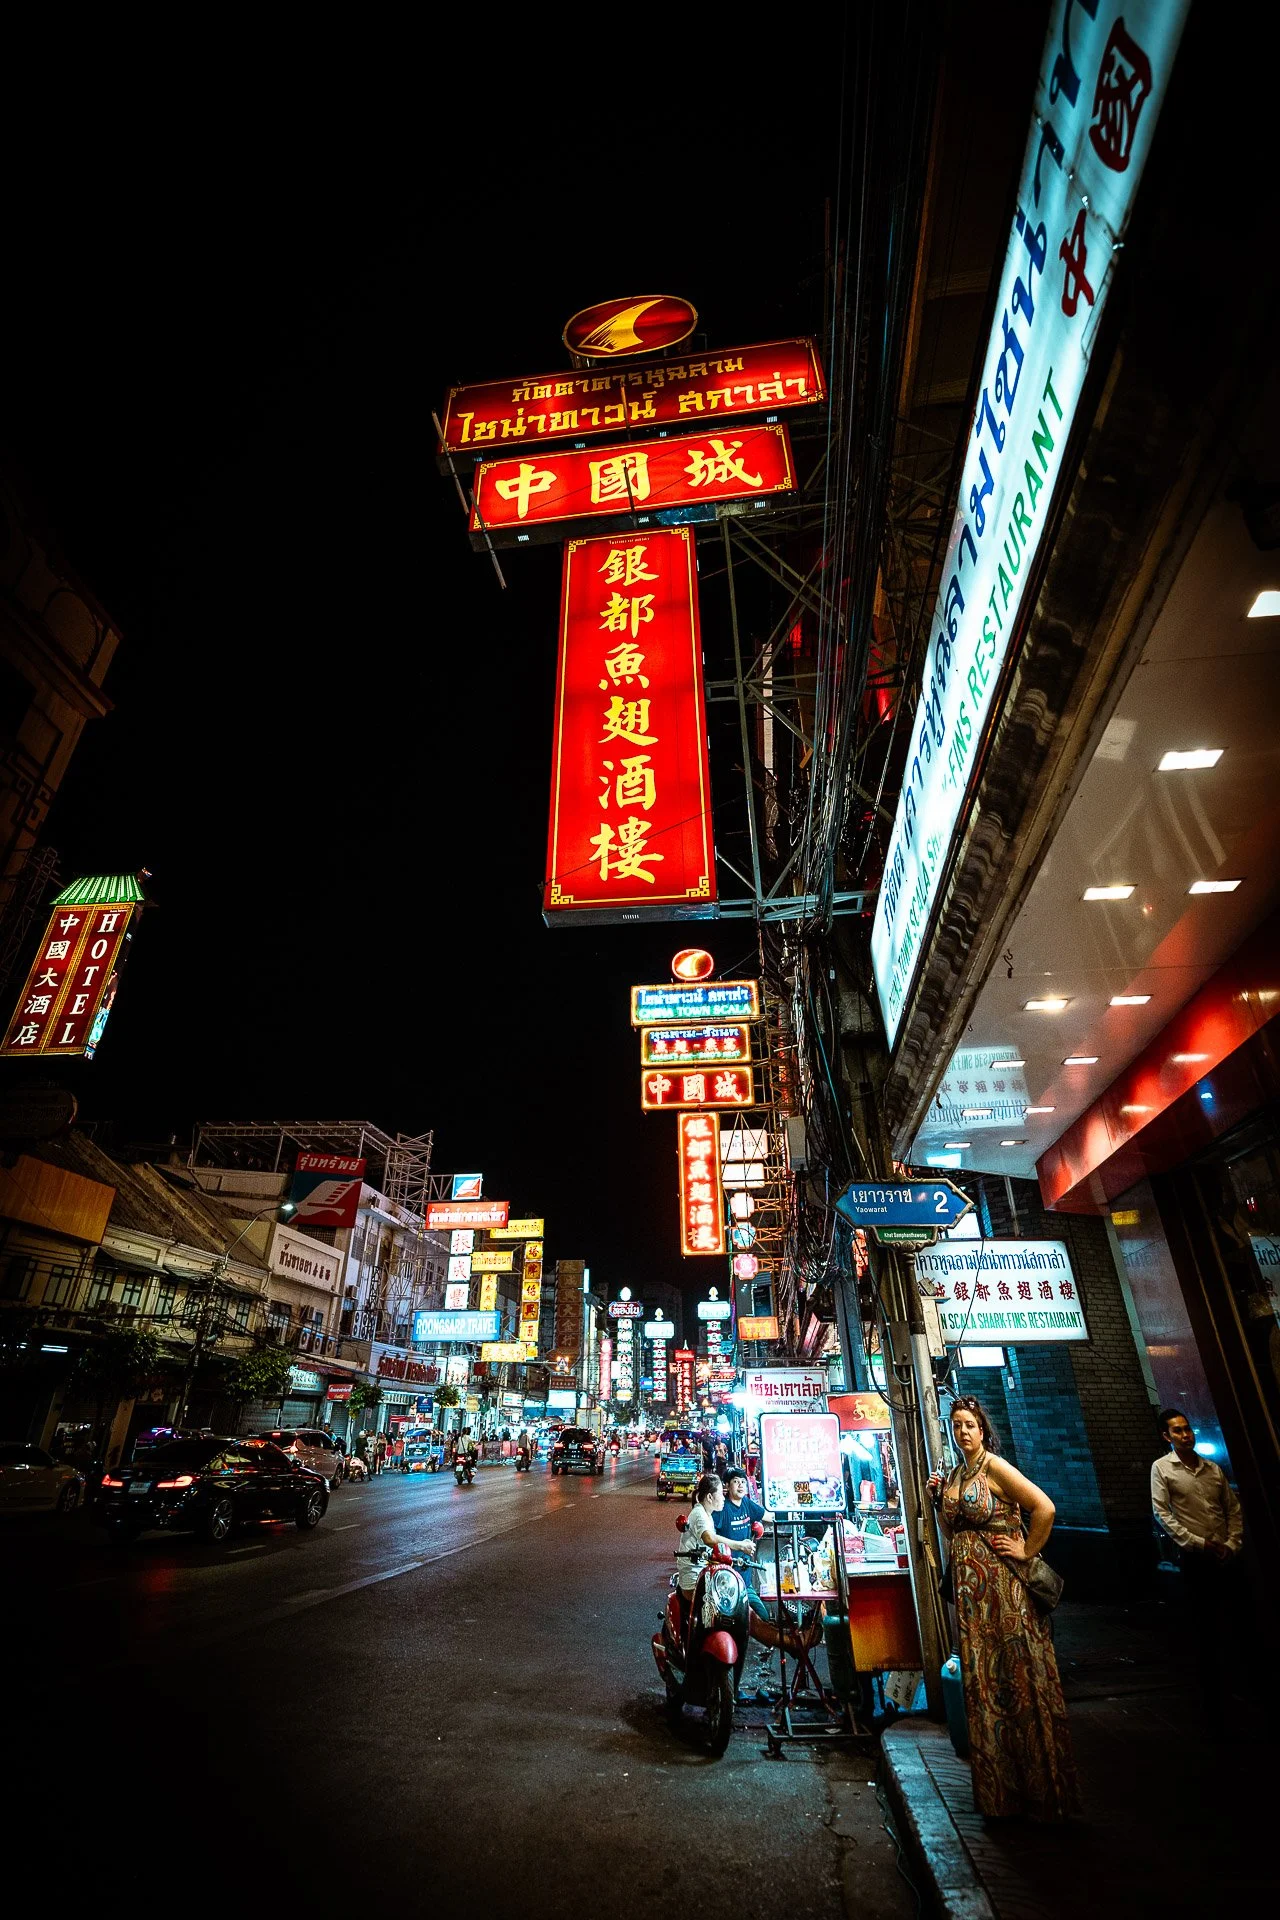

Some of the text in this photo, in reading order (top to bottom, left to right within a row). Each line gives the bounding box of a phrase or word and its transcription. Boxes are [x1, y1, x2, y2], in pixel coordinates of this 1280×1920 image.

[512, 357, 745, 404] ภัตตาคารหูฉลาม
[457, 371, 808, 444] ไชน่าทาวน์ สกาล่า
[495, 439, 763, 519] 中國城
[909, 861, 931, 935] SCALA
[967, 365, 1063, 710] RESTAURANT
[588, 545, 664, 884] 銀都魚翅酒樓
[11, 914, 80, 1046] 中國大酒店
[59, 913, 120, 1044] HOTEL
[677, 1005, 711, 1017] TOWN
[713, 1003, 752, 1015] SCALA
[648, 1071, 742, 1104] 中國城
[300, 1154, 363, 1171] รุ่งทรัพย์
[852, 1188, 949, 1213] เยาวราช 2
[467, 1316, 498, 1333] TRAVEL
[949, 1313, 977, 1330] SCALA
[977, 1311, 1028, 1330] SHARK-FINS
[1028, 1311, 1083, 1329] RESTAURANT
